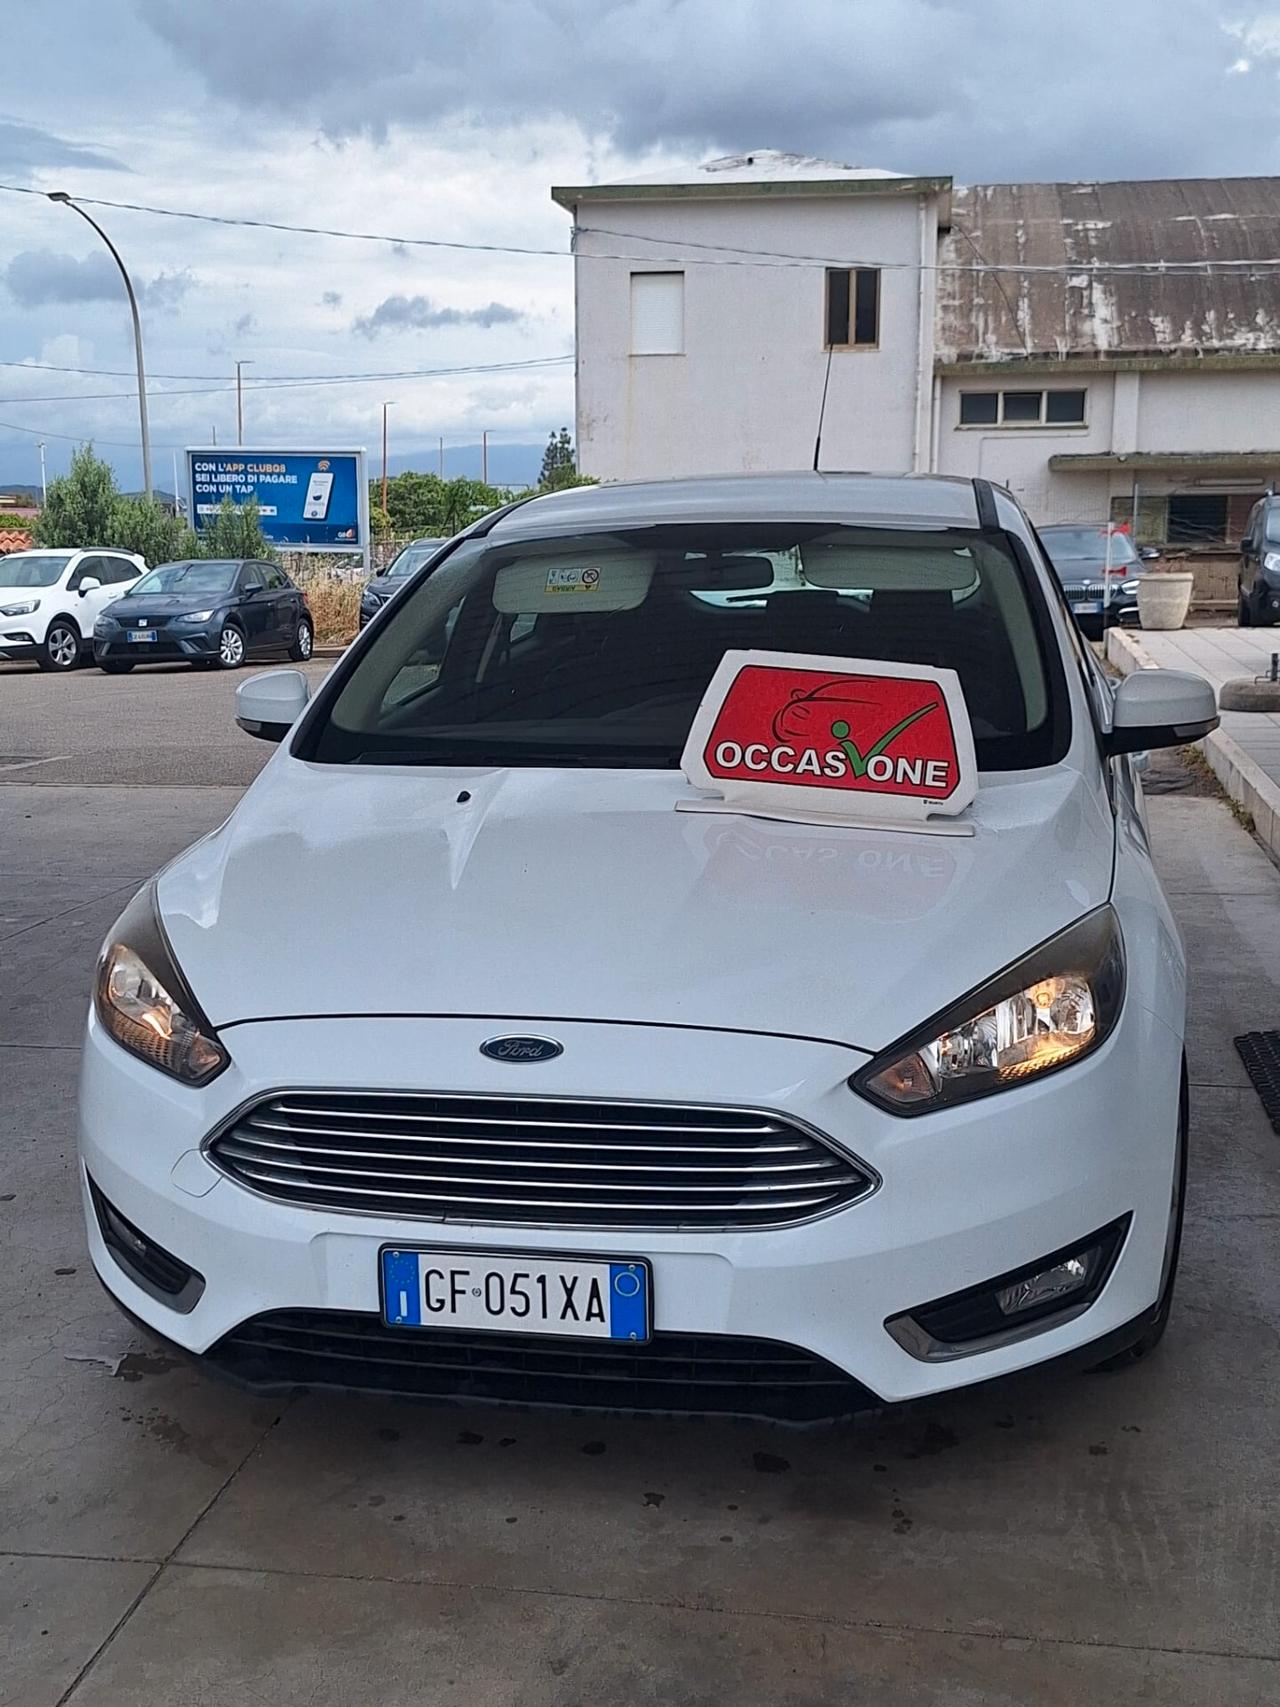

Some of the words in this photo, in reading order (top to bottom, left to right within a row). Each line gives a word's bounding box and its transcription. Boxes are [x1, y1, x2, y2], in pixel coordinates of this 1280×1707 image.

[194, 462, 216, 472] CON
[218, 462, 245, 473] L'APP
[246, 463, 287, 473] CLUBQ8
[195, 473, 210, 482] SEI
[211, 473, 246, 483] LIBERO
[247, 474, 257, 483] DI
[259, 474, 298, 484] PAGARE
[195, 483, 217, 493] CON
[218, 484, 233, 493] UN
[235, 484, 254, 493] TAP
[498, 1039, 544, 1057] Ford
